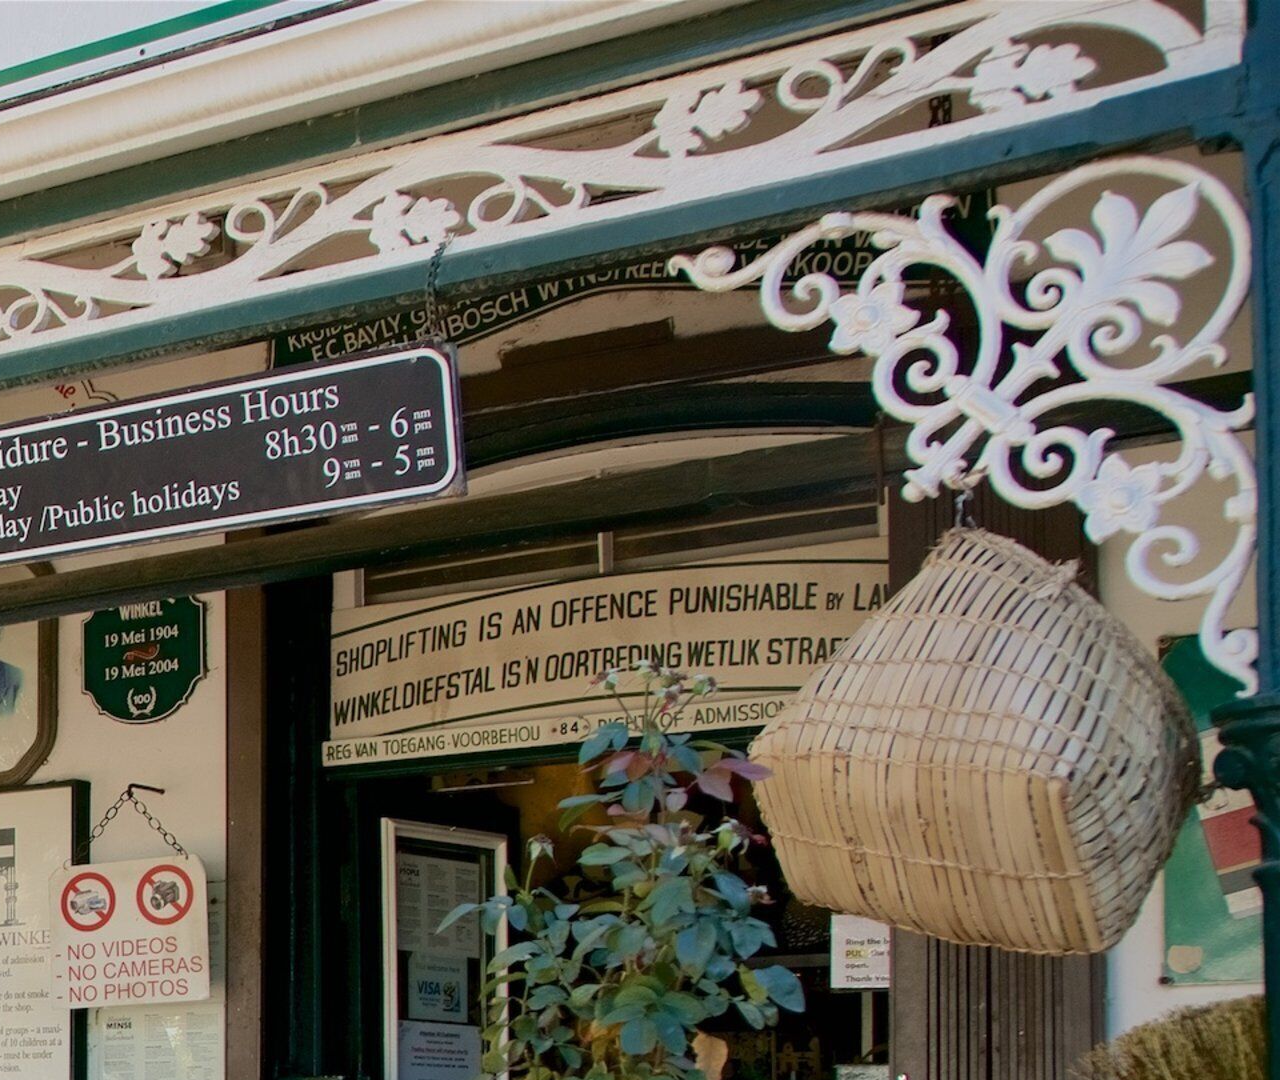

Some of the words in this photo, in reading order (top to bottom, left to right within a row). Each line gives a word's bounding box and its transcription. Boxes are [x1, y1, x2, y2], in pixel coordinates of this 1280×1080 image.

[97, 404, 232, 452] Business
[241, 384, 340, 425] Hours
[264, 420, 337, 460] 8h30
[391, 407, 410, 438] 6
[323, 458, 341, 488] 9
[394, 444, 411, 476] 5
[131, 480, 241, 516] holidays
[119, 602, 163, 621] WINKEL
[104, 634, 118, 648] 19
[122, 629, 146, 645] Mei
[148, 623, 179, 643] 1904
[336, 619, 467, 677] SHOPLIFTING
[479, 612, 503, 642] IS
[512, 604, 541, 636] AN
[551, 589, 658, 628] OFFENCE
[669, 582, 818, 616] PUNISHABLE
[826, 592, 844, 611] BY
[104, 667, 118, 681] 19
[122, 663, 146, 678] Mei
[148, 658, 179, 675] 2004
[334, 666, 495, 726] WINKELDIEFSTAL
[501, 660, 521, 689] IS
[545, 641, 681, 683] OORTREDING
[687, 639, 760, 667] WETLIK
[132, 693, 151, 705] 100
[327, 744, 352, 761] REG
[354, 742, 378, 759] VAN
[383, 735, 445, 756] TOEGANG
[597, 713, 645, 731] RHT
[660, 711, 684, 728] OF
[68, 942, 96, 961] NO
[101, 936, 178, 958] VIDEOS
[68, 963, 97, 982] NO
[103, 955, 203, 980] CAMERAS
[69, 983, 99, 1003] NO
[104, 977, 189, 1000] PHOTOS
[417, 980, 440, 996] VISA
